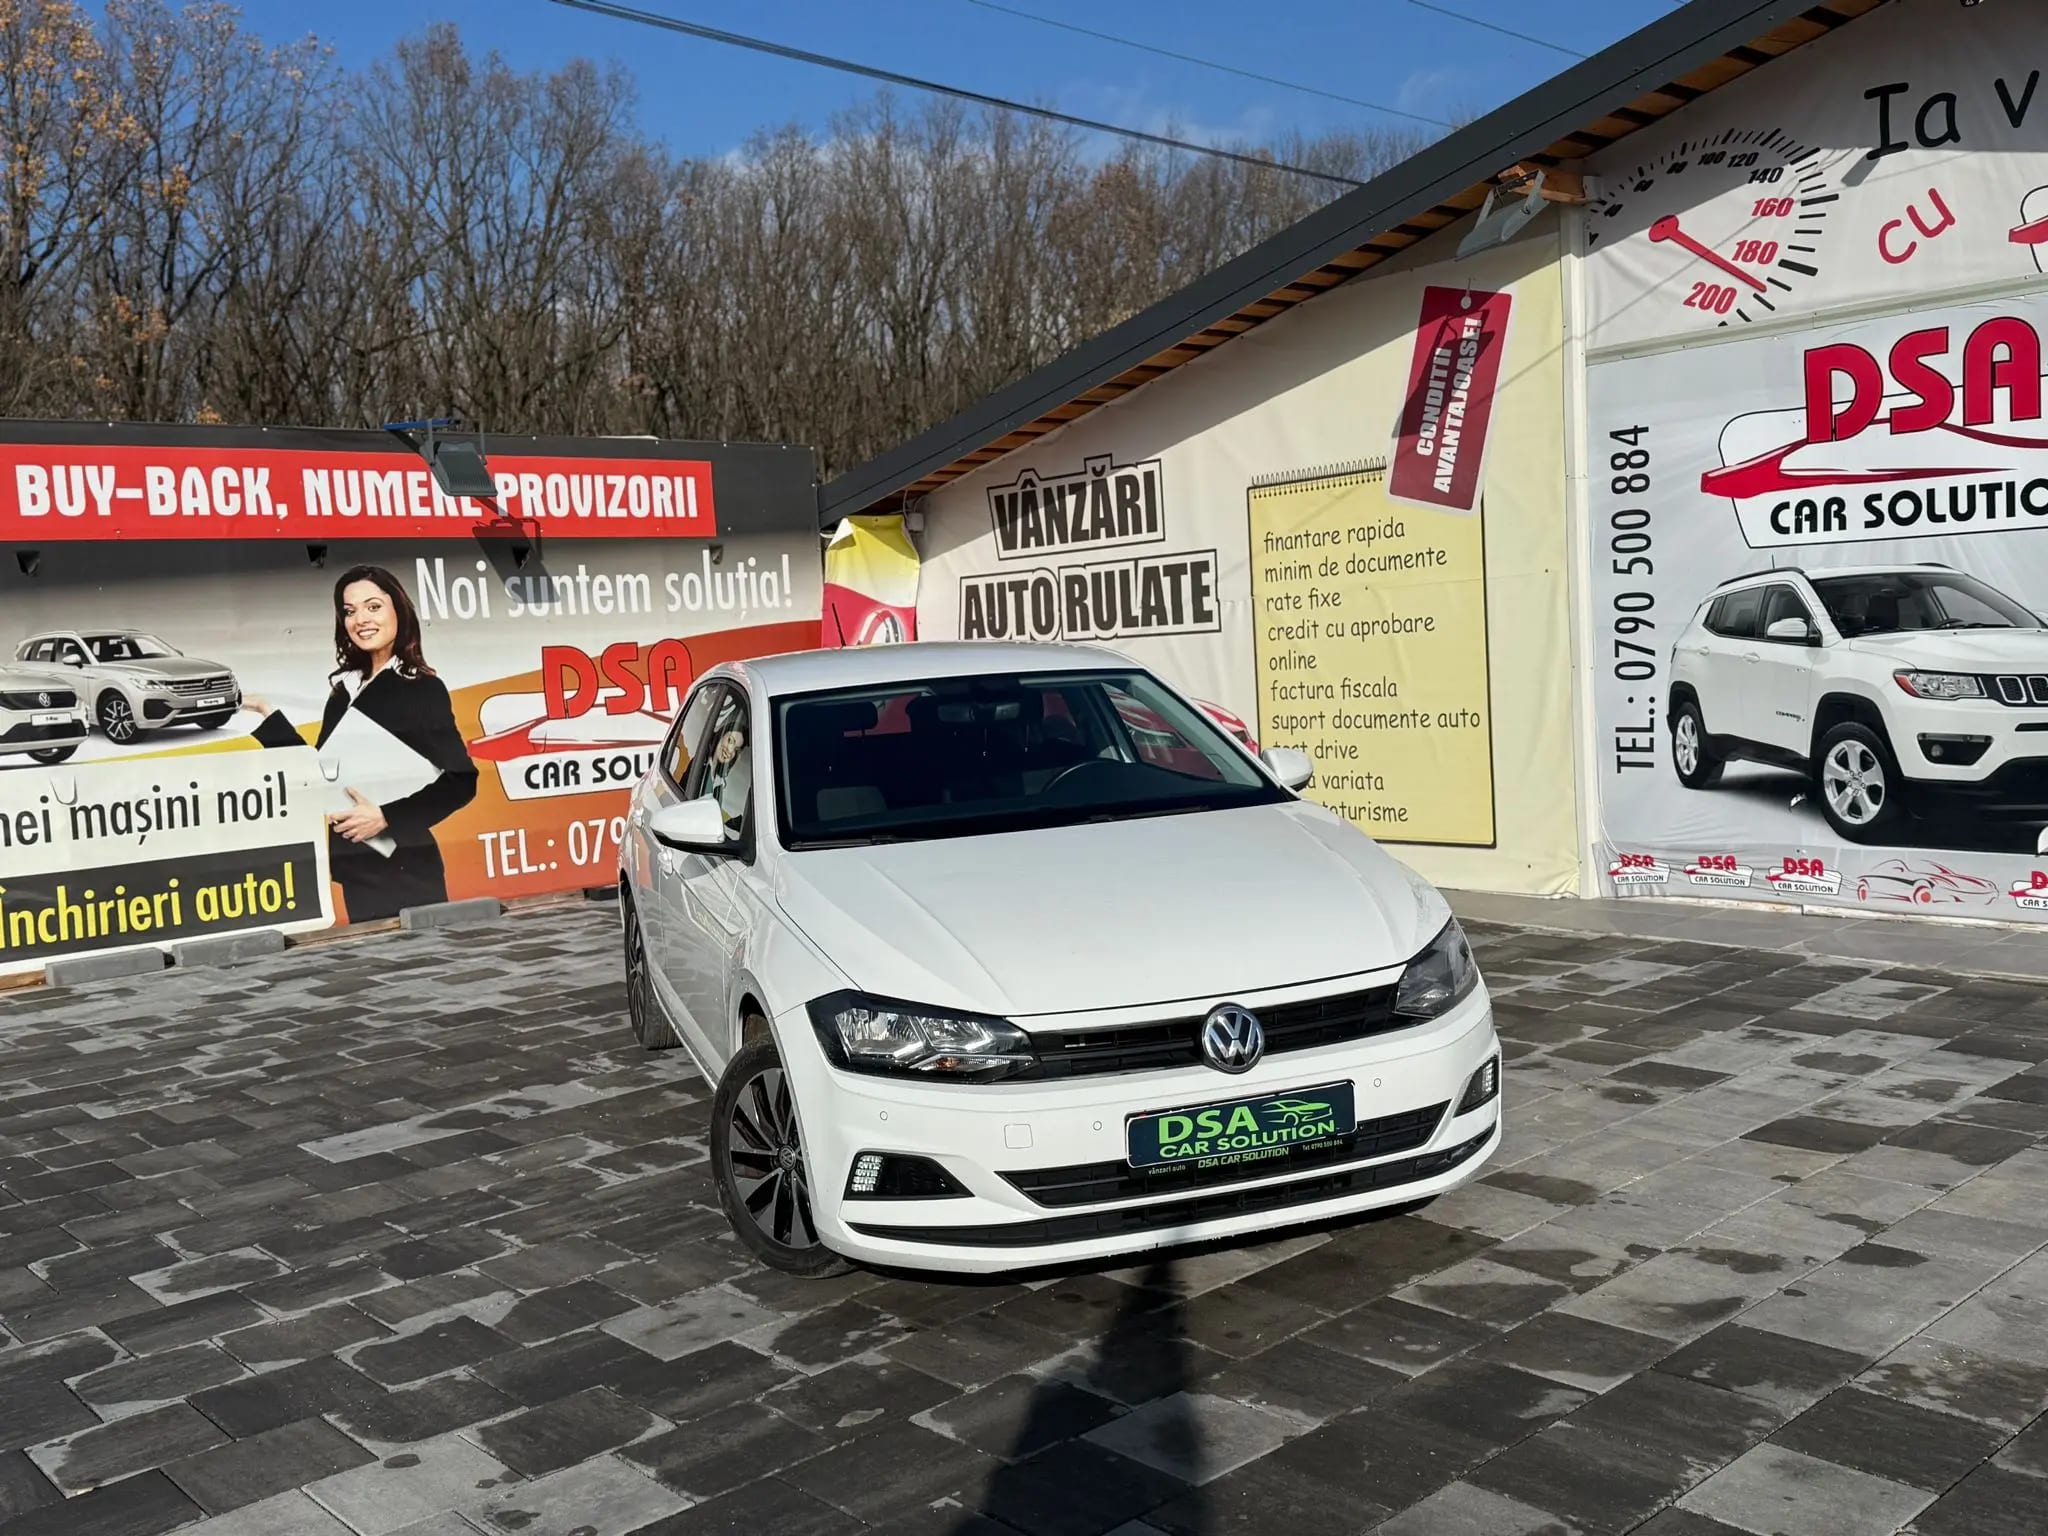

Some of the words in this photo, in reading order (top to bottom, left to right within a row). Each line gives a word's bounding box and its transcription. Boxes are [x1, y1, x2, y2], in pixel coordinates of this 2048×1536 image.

[1864, 82, 1961, 160] Ia
[1994, 70, 2040, 129] v
[1727, 152, 1760, 168] 120
[1747, 167, 1784, 184] 140
[1751, 197, 1795, 217] 160
[1878, 188, 1955, 264] cu
[1731, 239, 1780, 266] 180
[1683, 281, 1738, 315] 200
[1804, 316, 2042, 444] DSA
[1433, 317, 1483, 494] AVANTAJOASE!
[1609, 425, 1650, 494] 884
[15, 464, 289, 520] BUY-BACK,
[494, 472, 698, 518] PROVIZORII
[993, 464, 1158, 551] VÂNZĂRI
[1769, 496, 1847, 535] CAR
[1264, 528, 1341, 553] finantare
[1347, 516, 1405, 548] rapida
[1611, 509, 1653, 575] 500
[1265, 560, 1312, 583] minim
[1318, 556, 1339, 578] de
[1345, 547, 1447, 574] documente
[415, 557, 491, 620] Noi
[505, 563, 651, 617] suntem
[964, 576, 1059, 640] AUTO
[1063, 560, 1214, 632] RULATE
[1266, 592, 1302, 612] rate
[1308, 587, 1342, 610] fixe
[1268, 619, 1319, 641] credit
[1326, 621, 1345, 638] cu
[1350, 612, 1435, 642] aprobare
[1614, 592, 1656, 681] 0790
[1269, 649, 1317, 671] online
[541, 638, 693, 719] DSA
[1270, 680, 1334, 702] factura
[1340, 676, 1398, 700] fiscala
[1271, 710, 1325, 735] suport
[1332, 708, 1431, 730] documente
[1437, 708, 1481, 728] auto
[1615, 696, 1656, 774] TEL.:
[1314, 739, 1359, 759] drive
[524, 760, 581, 790] CAR
[1322, 770, 1384, 791] variata
[69, 781, 200, 846] mașini
[217, 770, 289, 824] noi!
[1631, 874, 1664, 882] SOLUTION
[1698, 855, 1737, 871] DSA
[1783, 857, 1824, 877] DSA
[195, 861, 296, 923] auto!
[1710, 877, 1746, 886] SOLUTION
[1794, 883, 1834, 893] SOLUTION
[1158, 1105, 1260, 1145] DSA
[1159, 1141, 1209, 1158] CAR
[1217, 1119, 1335, 1151] SOLUTION
[1198, 1158, 1219, 1169] DSA
[1220, 1154, 1240, 1165] CAR
[1242, 1147, 1289, 1162] SOLUTION
